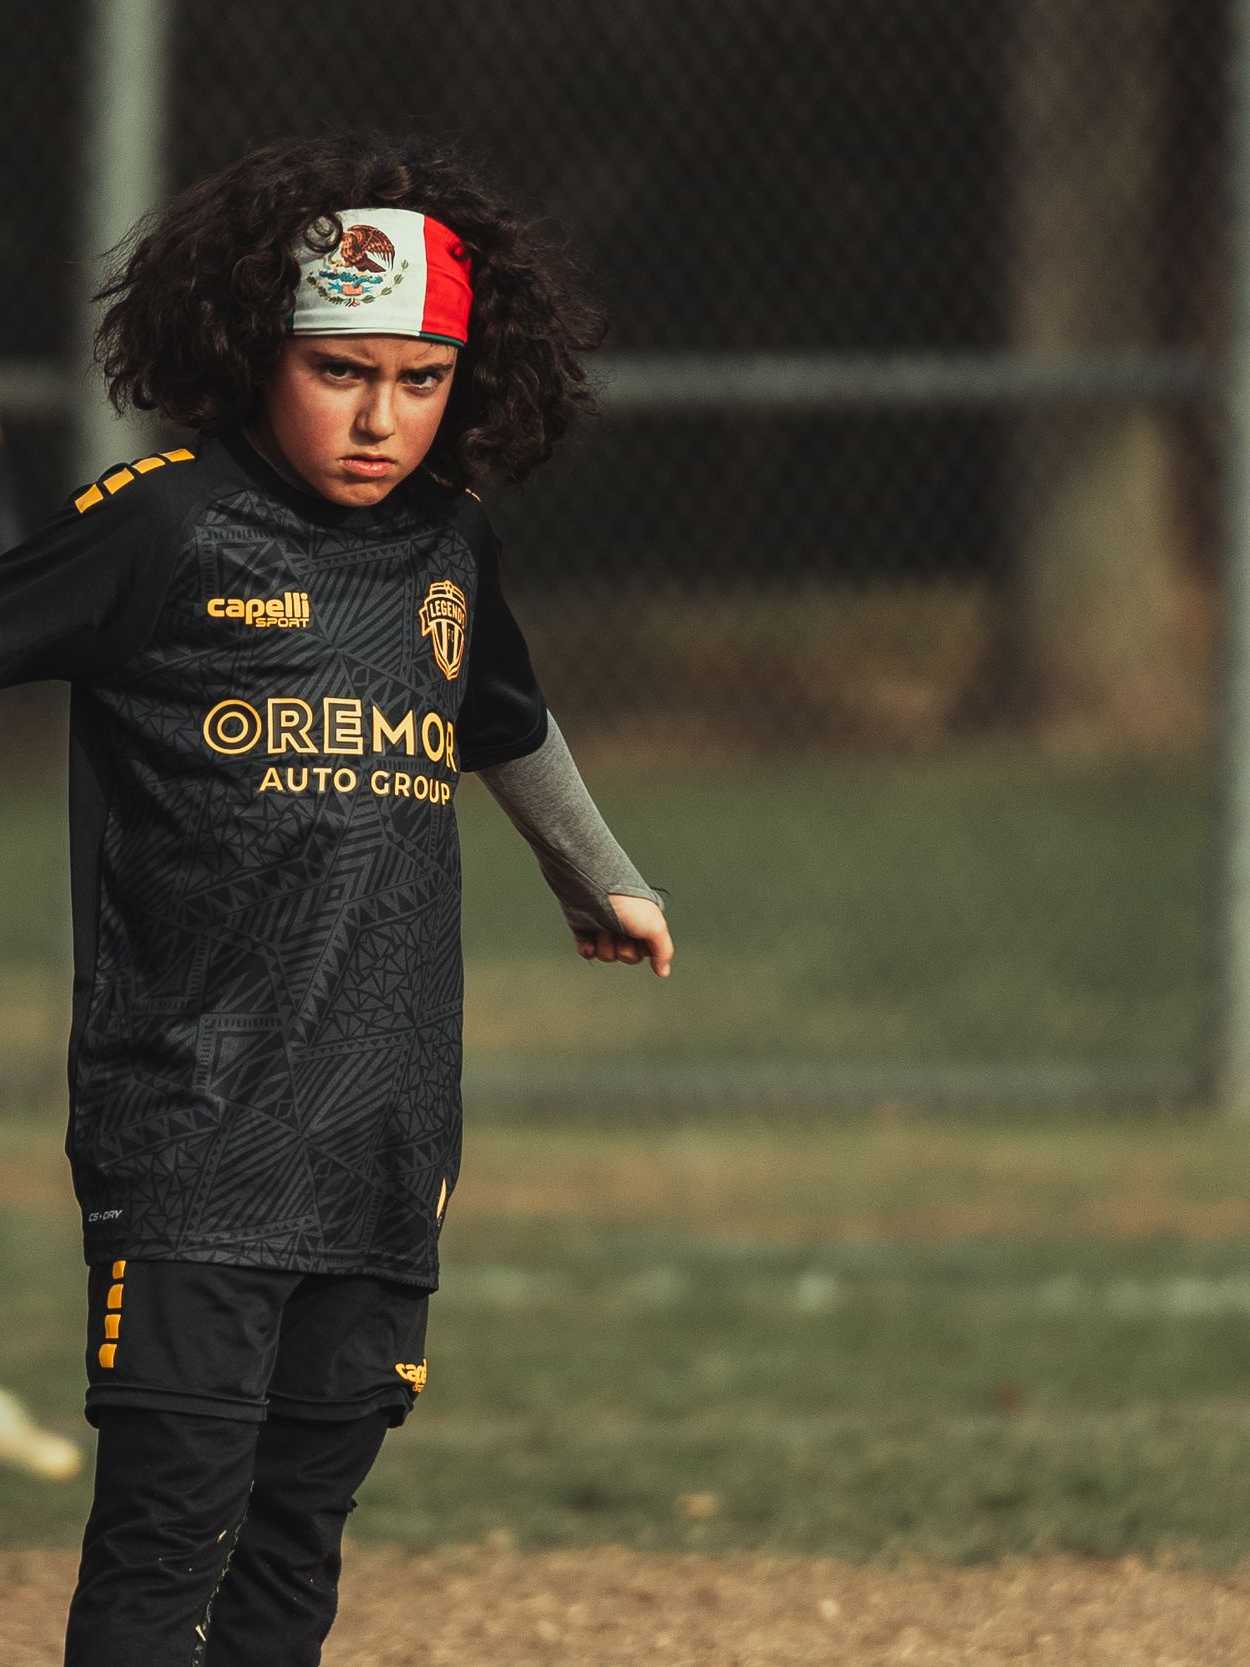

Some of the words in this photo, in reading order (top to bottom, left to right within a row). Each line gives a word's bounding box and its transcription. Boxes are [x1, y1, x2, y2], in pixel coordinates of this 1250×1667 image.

[206, 591, 310, 625] capelli
[255, 617, 310, 629] SPORT
[258, 767, 357, 794] AUTO
[370, 771, 451, 806] GROUP
